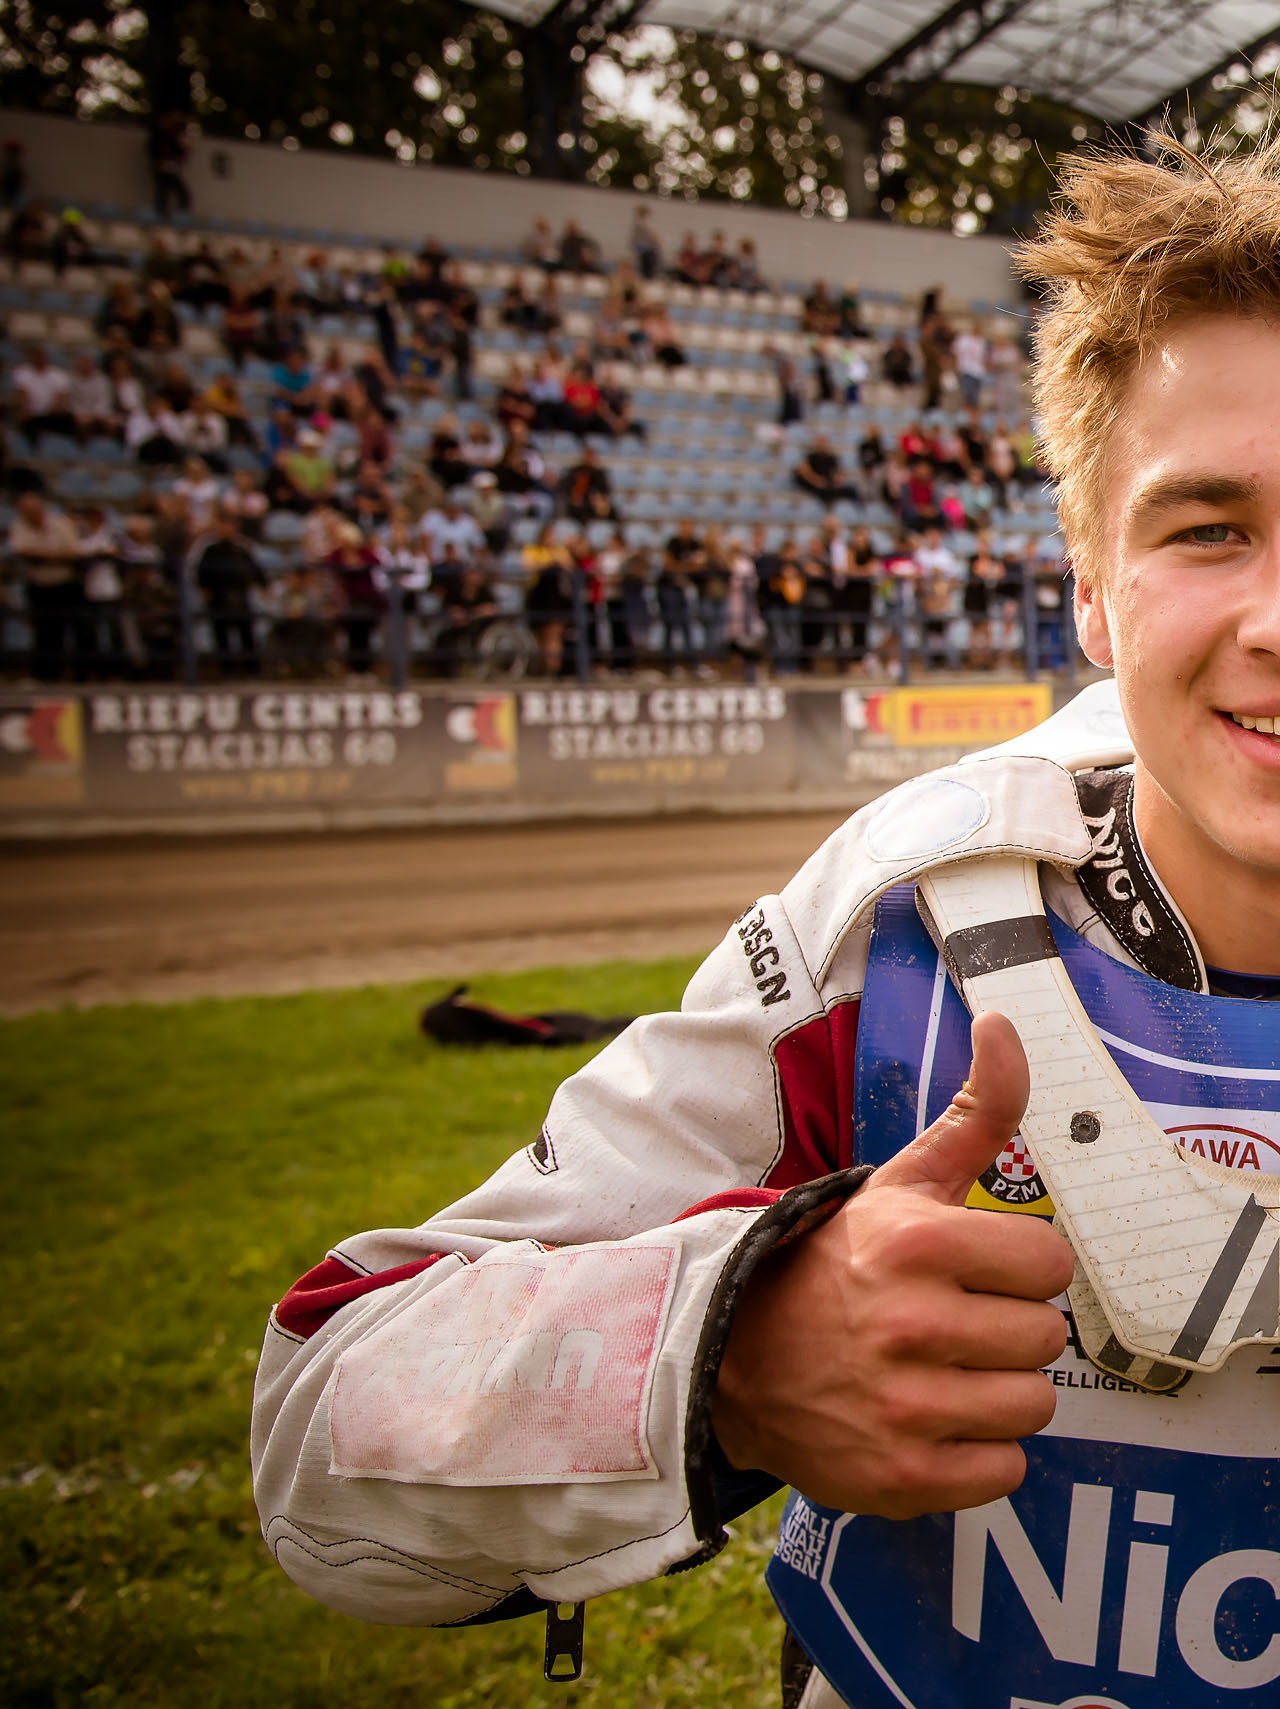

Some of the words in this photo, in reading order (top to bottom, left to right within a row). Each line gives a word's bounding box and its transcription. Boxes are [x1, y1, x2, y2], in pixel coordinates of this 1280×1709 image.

[91, 694, 239, 732] RIEPU
[251, 692, 423, 729] CENTRS
[522, 690, 640, 725] RIEPU
[648, 688, 787, 722] CENTRS
[126, 733, 334, 772] STACIJAS
[343, 730, 398, 766] 60
[549, 725, 706, 760] STACIJAS
[718, 723, 765, 755] 60
[990, 1178, 1042, 1201] PZM
